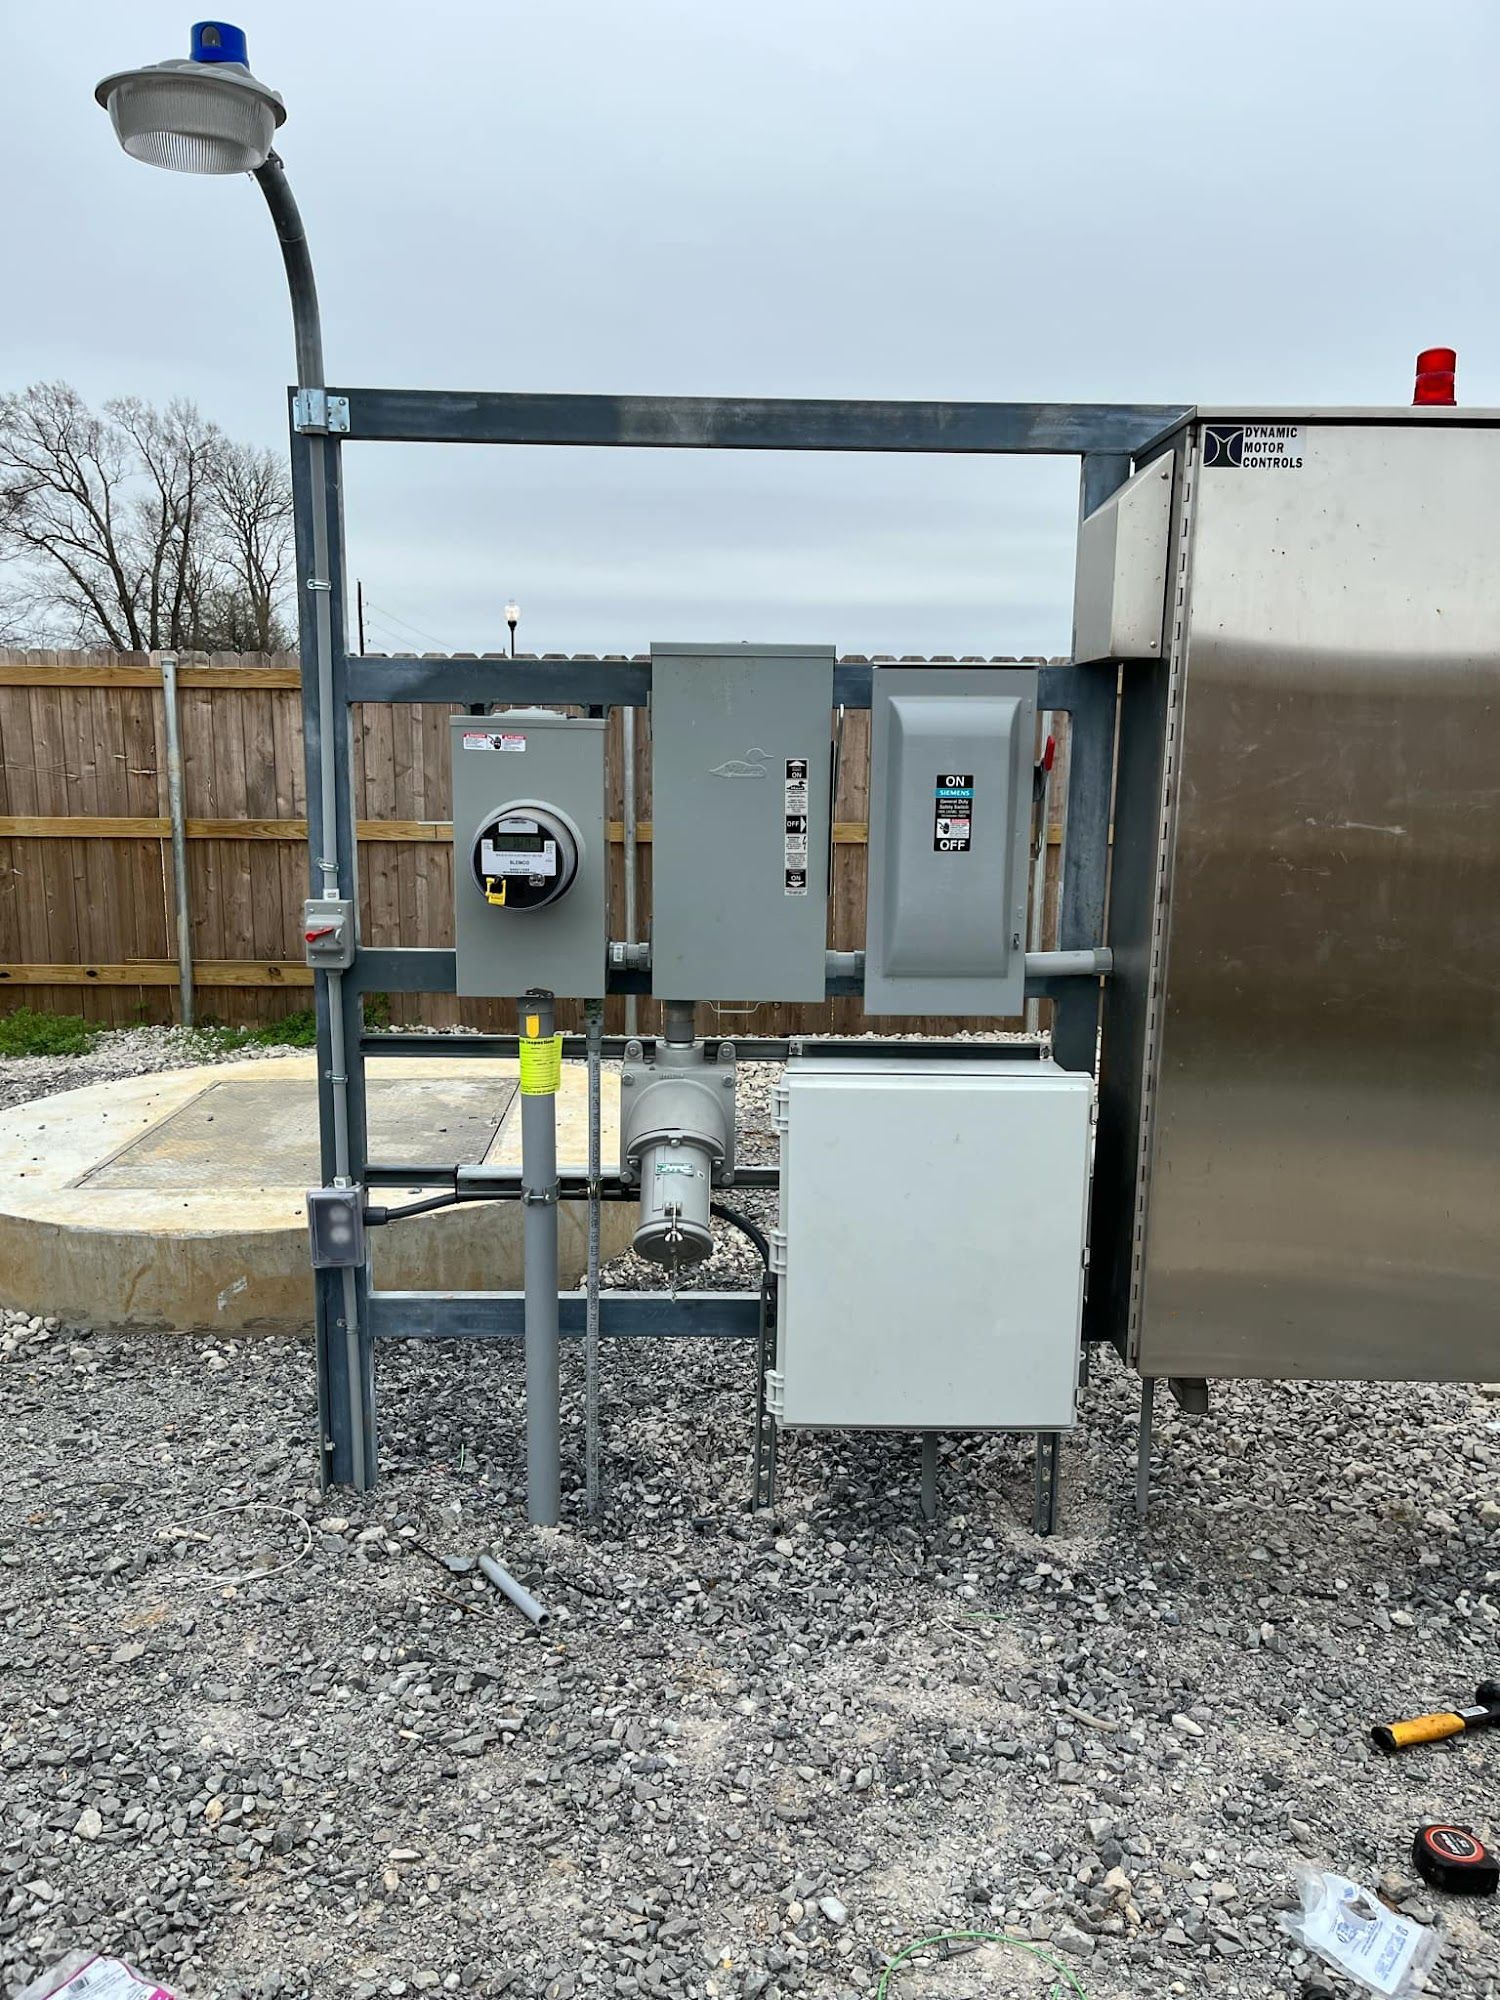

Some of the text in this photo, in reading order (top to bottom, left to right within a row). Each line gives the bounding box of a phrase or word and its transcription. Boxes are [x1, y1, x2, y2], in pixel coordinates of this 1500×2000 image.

[1245, 426, 1298, 438] DYNAMIC
[1243, 442, 1284, 453] MOTOR
[1242, 457, 1303, 468] CONTROLS
[791, 771, 802, 779] ON
[945, 776, 965, 787] ON
[786, 820, 800, 828] OFF
[940, 839, 966, 851] OFF
